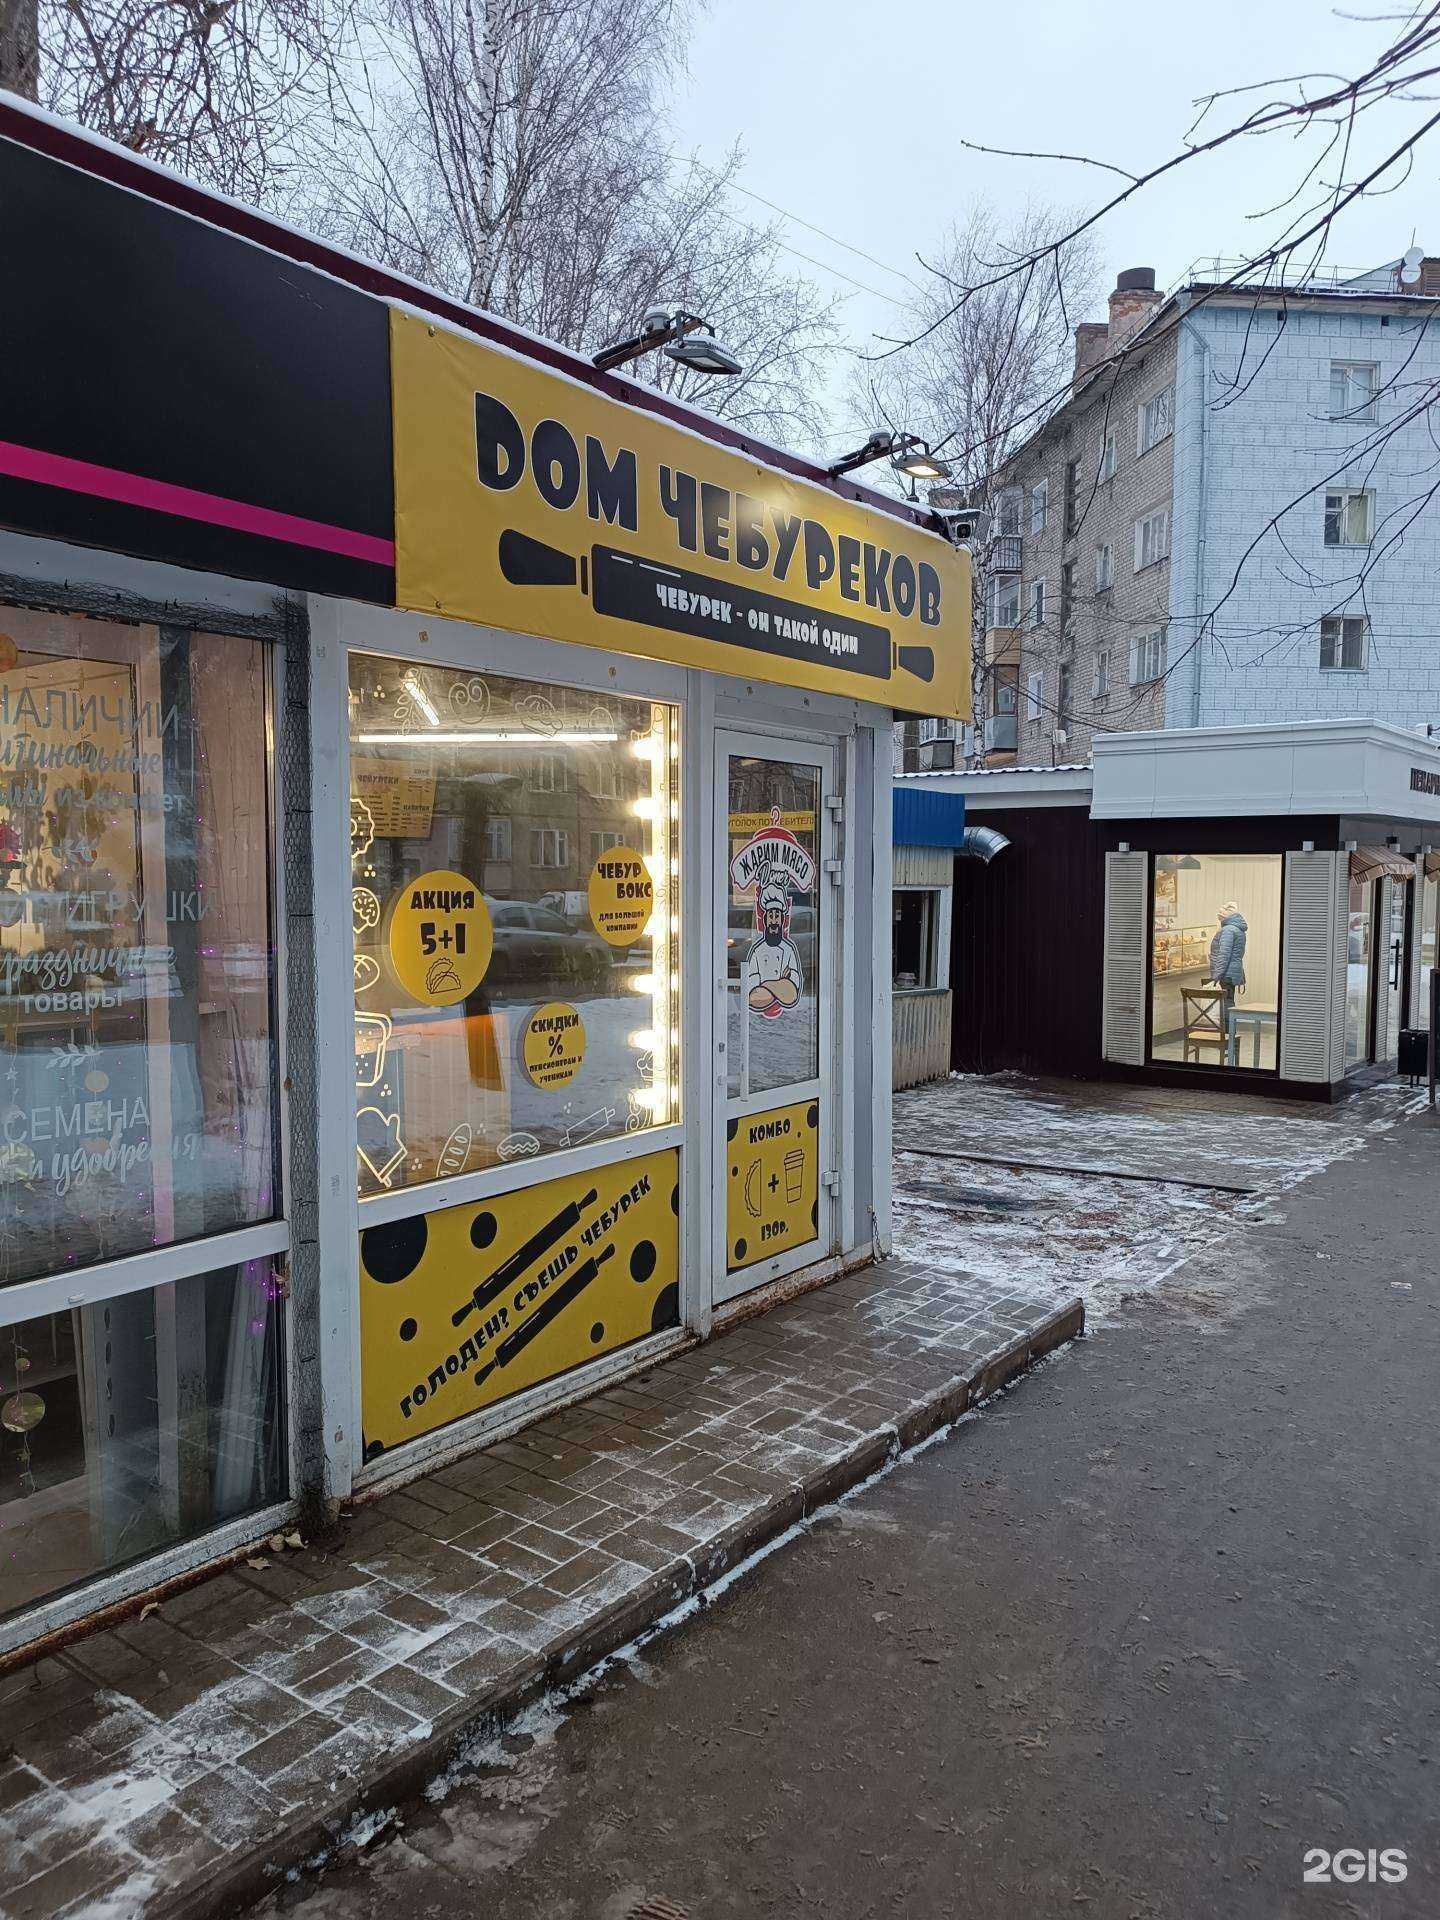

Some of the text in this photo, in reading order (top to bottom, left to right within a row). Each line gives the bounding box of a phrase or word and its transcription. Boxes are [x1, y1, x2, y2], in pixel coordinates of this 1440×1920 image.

[659, 464, 942, 627] ЧЕБУРЕКОВ
[656, 583, 732, 623] ЧЕБУРЕК
[748, 609, 769, 632] ОН
[774, 620, 818, 645] ТАКОЙ
[822, 628, 858, 655] ОДИН
[597, 862, 641, 879] ЧЕБУР
[739, 842, 809, 880] ЖАРИМ МЯСО
[411, 890, 475, 914] АКЦИЯ
[616, 882, 652, 899] БОКС
[20, 989, 122, 1016] товары
[531, 1013, 579, 1033] СКИДКИ
[548, 1034, 563, 1058] %
[529, 1058, 577, 1072] ПЕНСИОНЕРАМ
[539, 1070, 573, 1084] УЧЕНИКАМ
[4, 1097, 150, 1143] СЕМЕНА
[749, 1118, 791, 1144] КОМБО
[52, 1134, 201, 1197] удобреия
[400, 1174, 652, 1419] ГОЛОДЕН? СЪЕШЬ ЧЕБУРЕК
